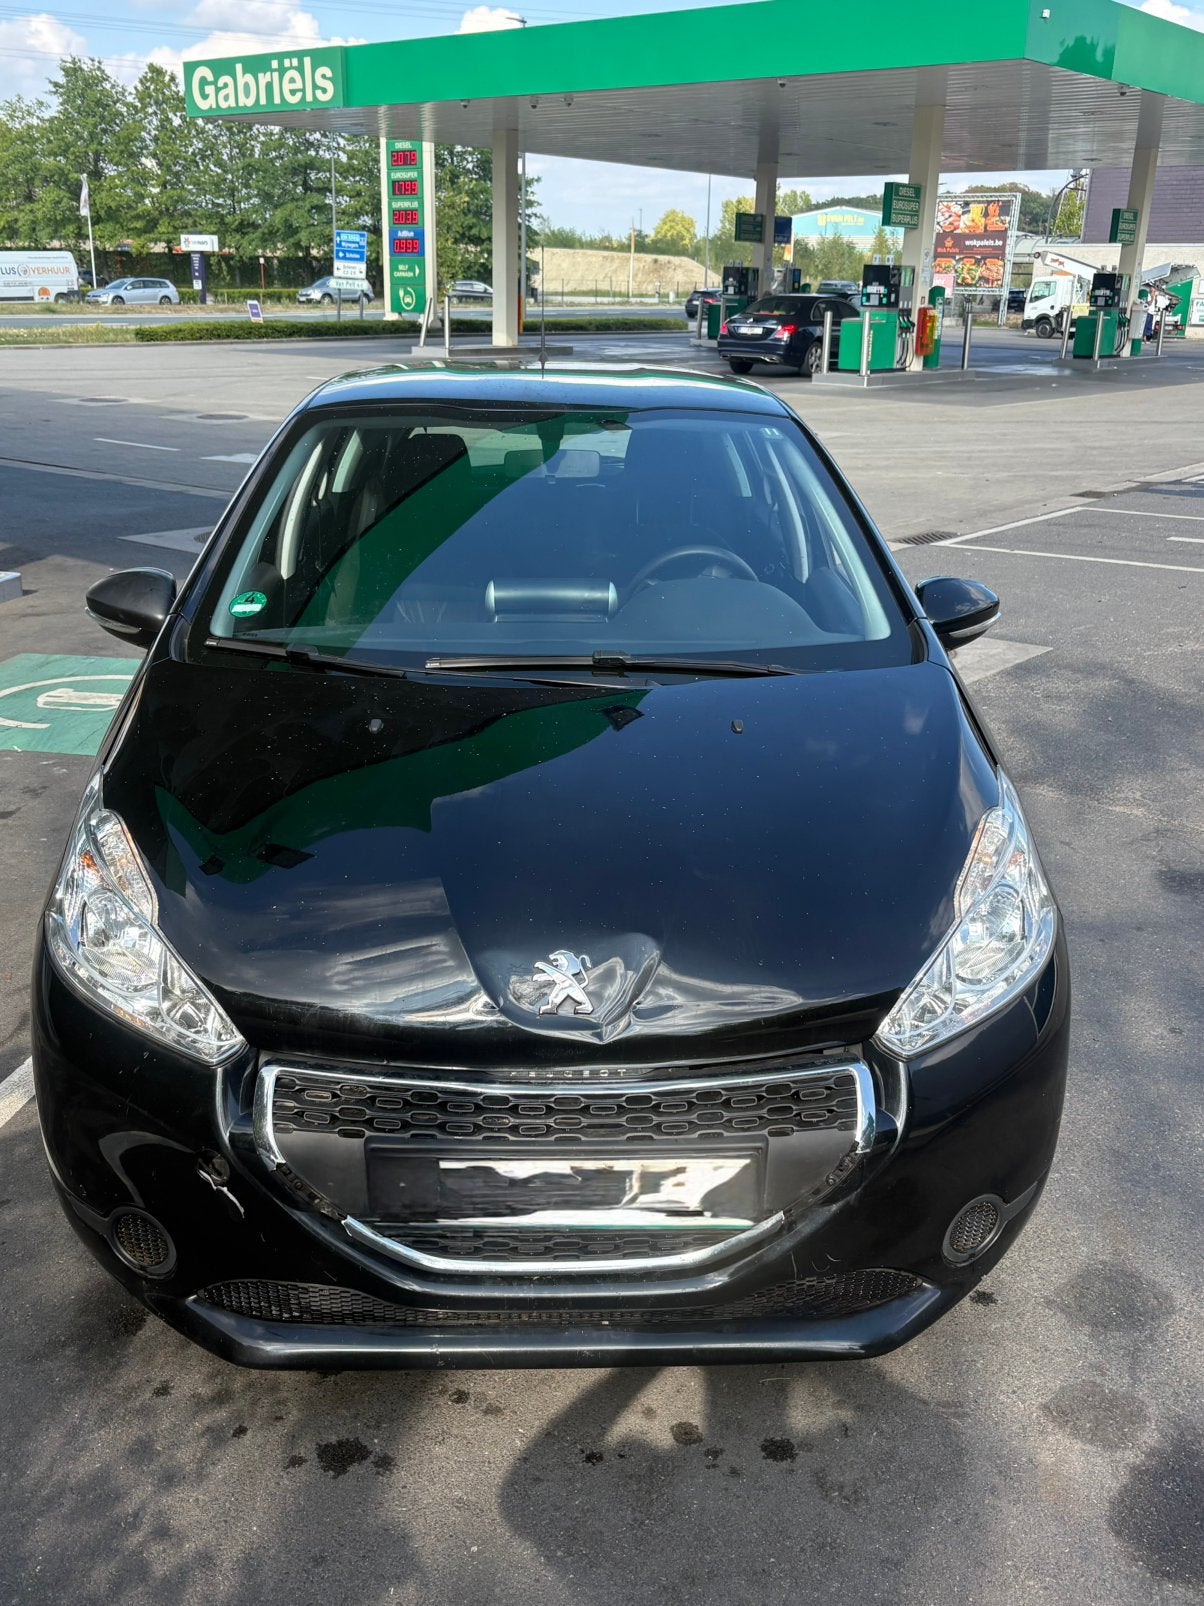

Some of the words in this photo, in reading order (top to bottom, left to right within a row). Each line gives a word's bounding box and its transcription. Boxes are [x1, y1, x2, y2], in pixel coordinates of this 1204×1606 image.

[192, 56, 335, 110] Gabriëls
[899, 187, 915, 197] DIESEL
[893, 200, 919, 210] EUROSUPER
[893, 214, 918, 224] SUPERPLUS
[964, 239, 1003, 247] wokpaleis.be
[30, 266, 71, 275] VERHUUR
[244, 592, 255, 604] 4
